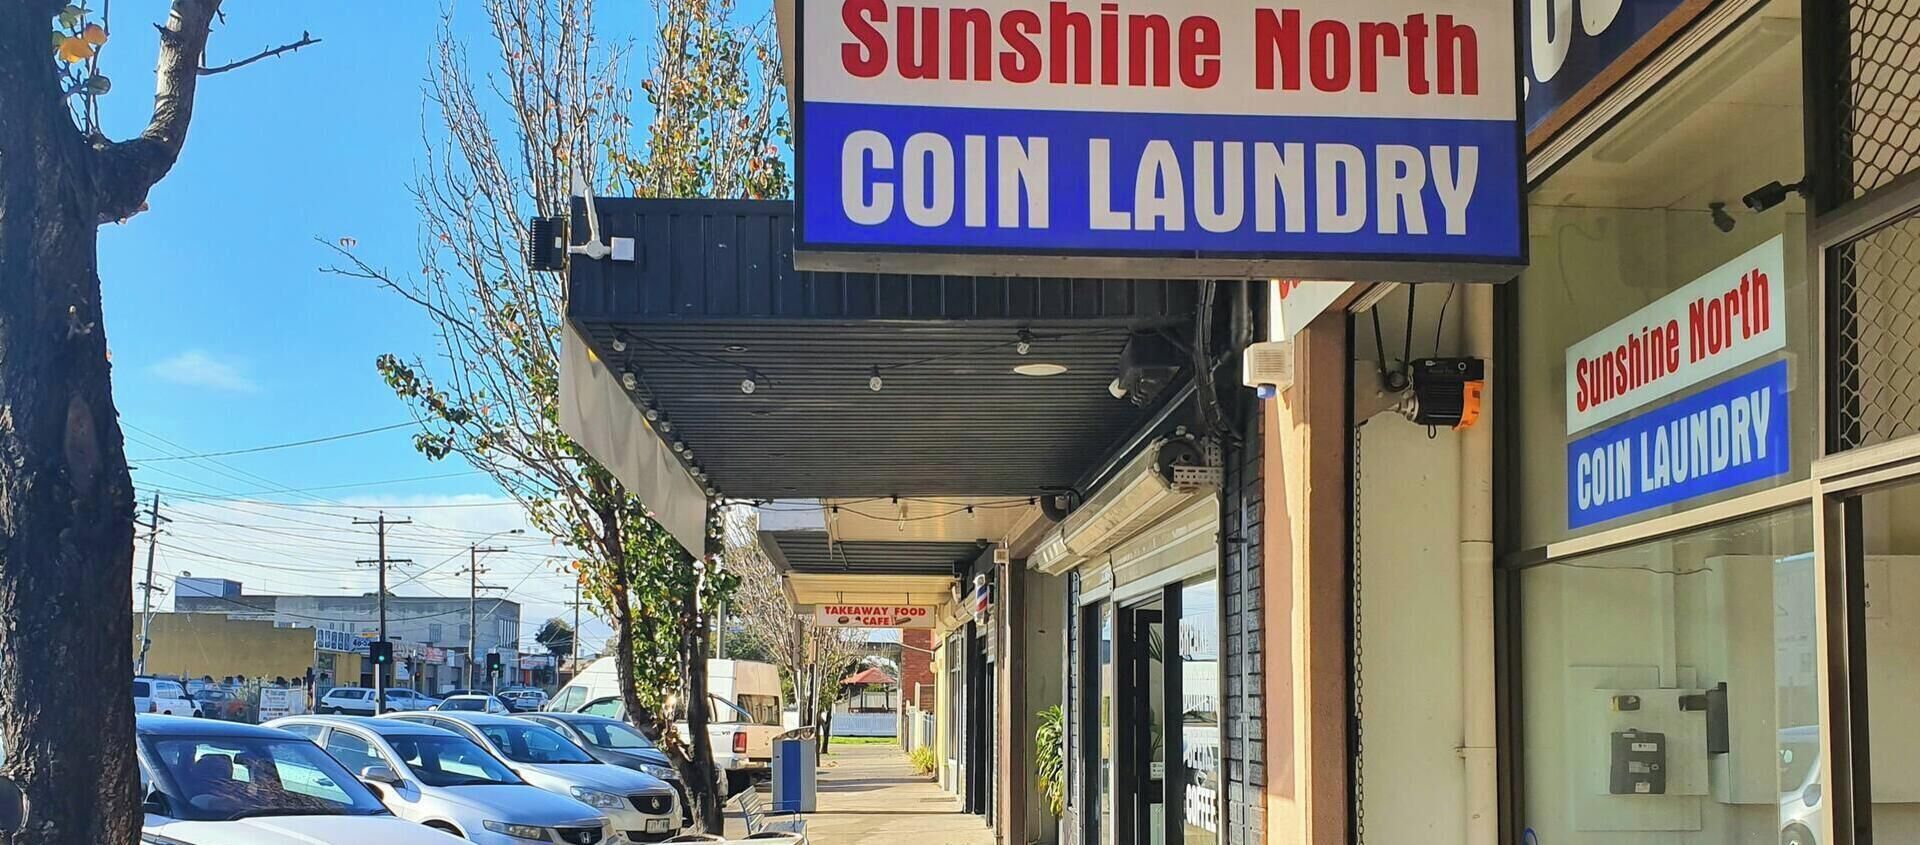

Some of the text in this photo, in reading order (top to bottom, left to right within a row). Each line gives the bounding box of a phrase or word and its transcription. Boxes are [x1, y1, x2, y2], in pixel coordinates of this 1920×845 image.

[841, 0, 1221, 89] Sunshine
[1255, 8, 1479, 95] North
[841, 131, 1479, 235] COIN LAUNDRY
[1576, 268, 1769, 412] Sunshine North
[1577, 387, 1770, 511] COIN LAUNDRY
[824, 606, 926, 616] TAKEAWAY FOOD
[862, 616, 889, 625] CAFE
[1185, 783, 1217, 833] COFFEE
